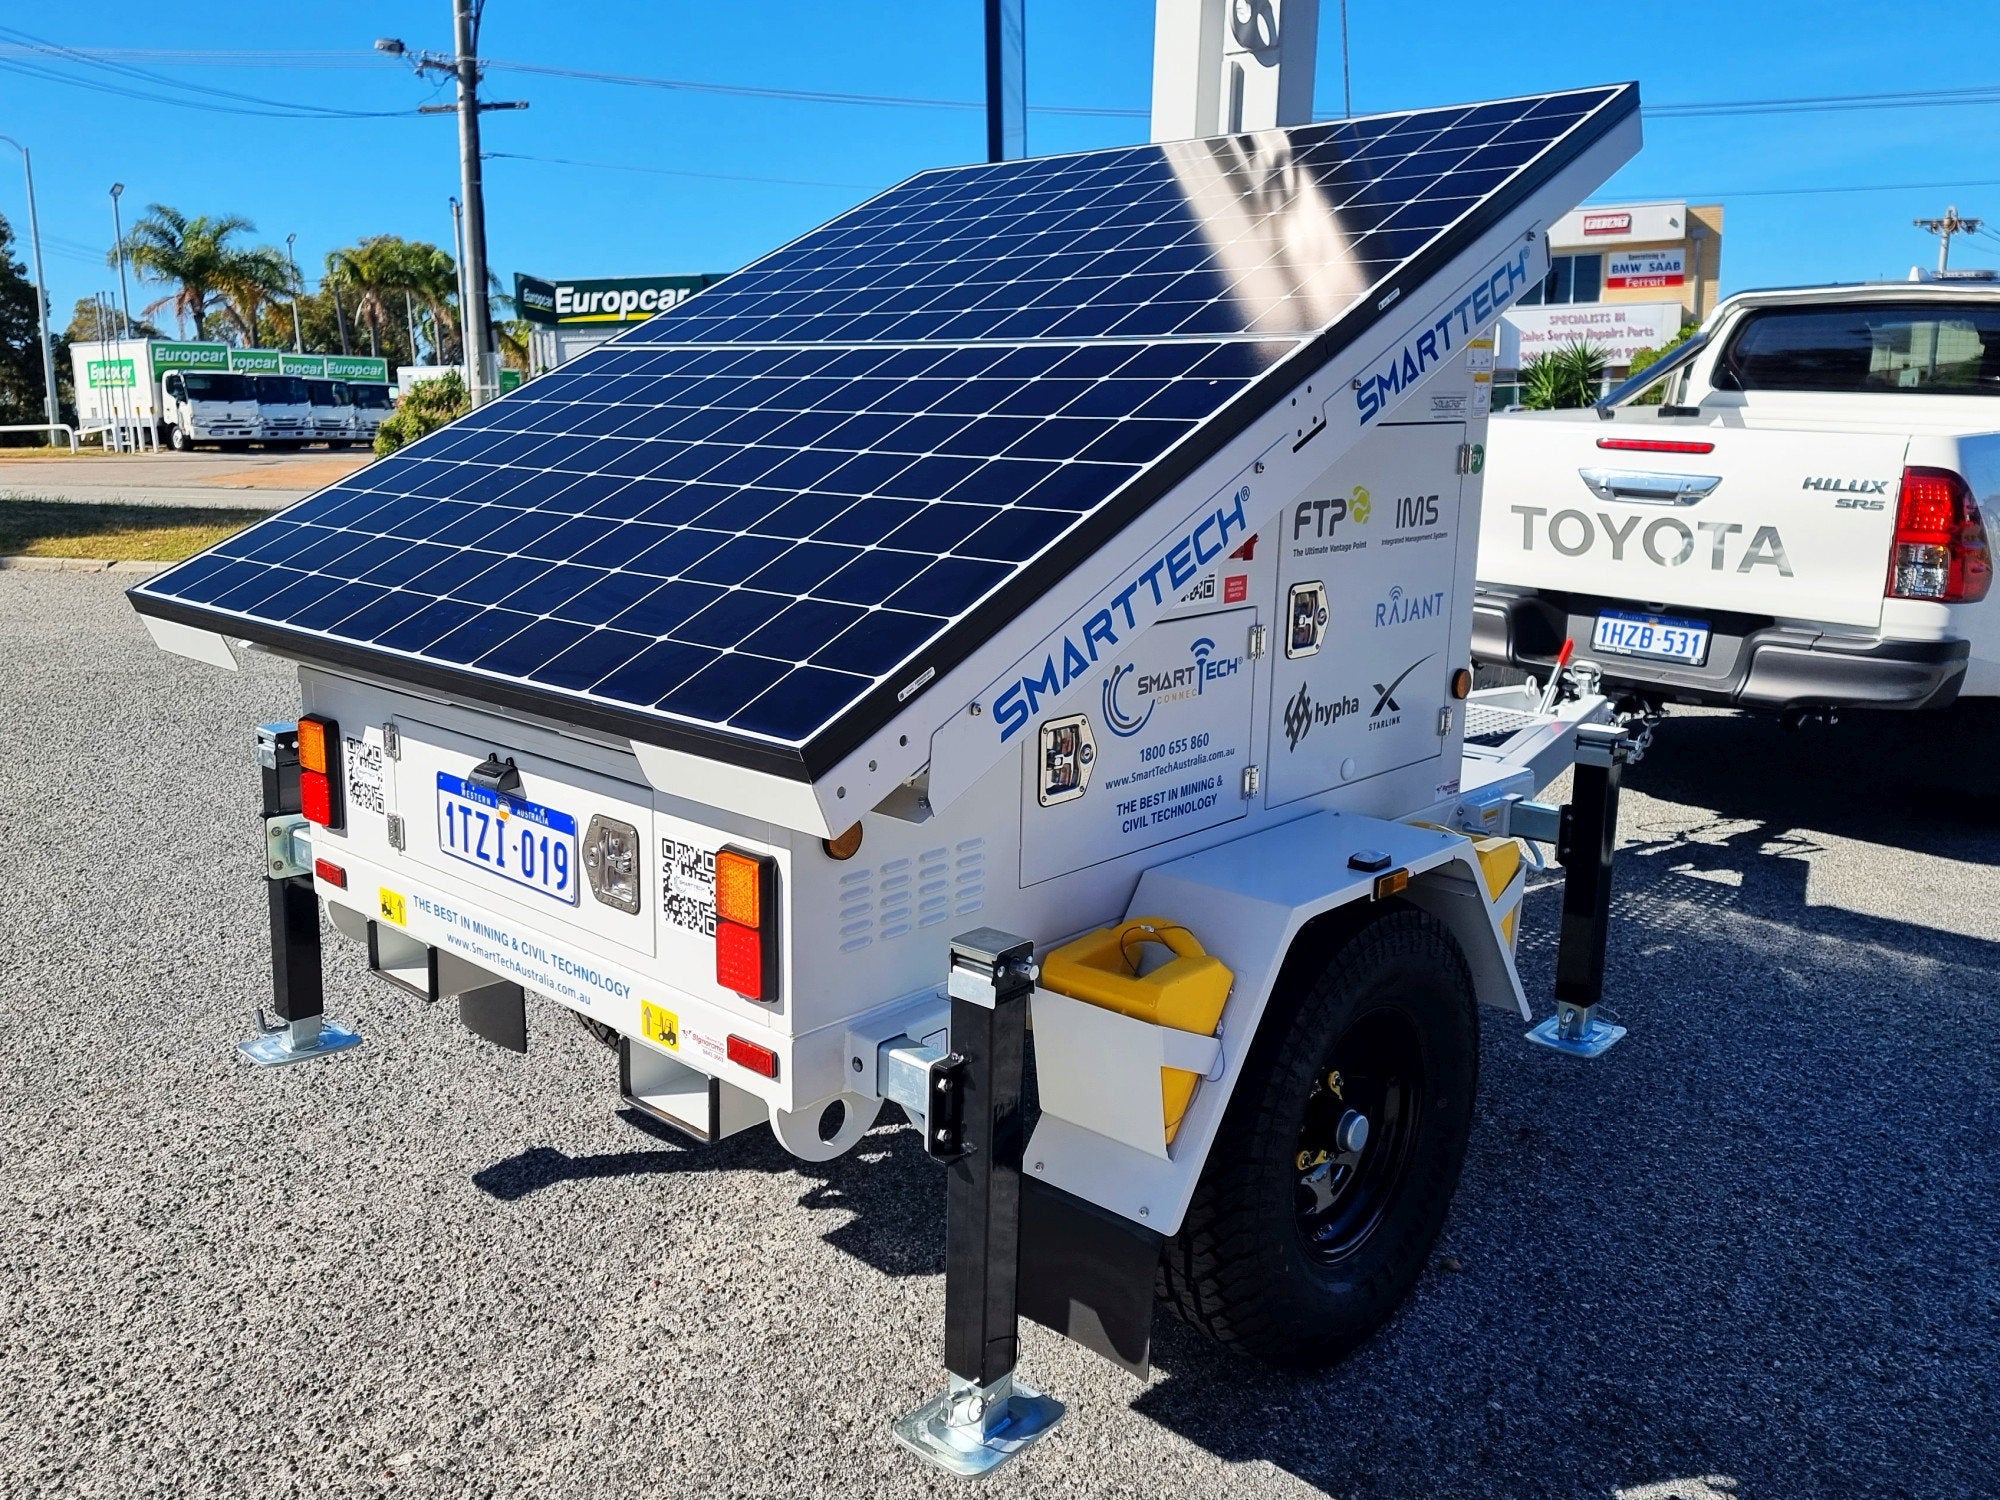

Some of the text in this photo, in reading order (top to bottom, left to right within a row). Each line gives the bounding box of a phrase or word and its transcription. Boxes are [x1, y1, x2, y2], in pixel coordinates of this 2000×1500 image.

[1612, 261, 1681, 274] BMW SAAB
[1625, 276, 1667, 288] Ferrari
[555, 286, 691, 320] Europcar
[1549, 313, 1611, 326] SPECIALISTS
[1547, 328, 1584, 341] Service
[1586, 326, 1625, 342] Repairs
[1627, 325, 1655, 338] Parts
[154, 347, 227, 365] Europcar
[327, 361, 383, 377] Europcar
[1802, 476, 1890, 495] HILUX
[1396, 495, 1440, 529] IMS
[1834, 498, 1887, 512] SR5
[1293, 498, 1347, 541] FTP
[1381, 531, 1448, 547] Integrated Management System
[1511, 505, 1794, 578] TOYOTA
[1293, 541, 1367, 558] The Ultimate Vantage Point
[1375, 592, 1444, 628] RAJANT
[1315, 695, 1360, 726] hypha
[1368, 715, 1401, 731] STARLINK
[1140, 732, 1210, 763] 1800 655 860
[1105, 748, 1235, 790] www.SmartTechAustralia.com.au
[461, 789, 491, 806] WESTERN
[1117, 775, 1223, 816] THE BEST IN MINING &
[516, 809, 549, 826] AUSTRALIA
[1122, 794, 1217, 833] CIVIL TECHNOLOGY
[413, 895, 631, 999] THE BEST IN MINING & CIVIL TECHNOLOGY
[447, 933, 591, 1005] www.SmartTechAustralia.com.au
